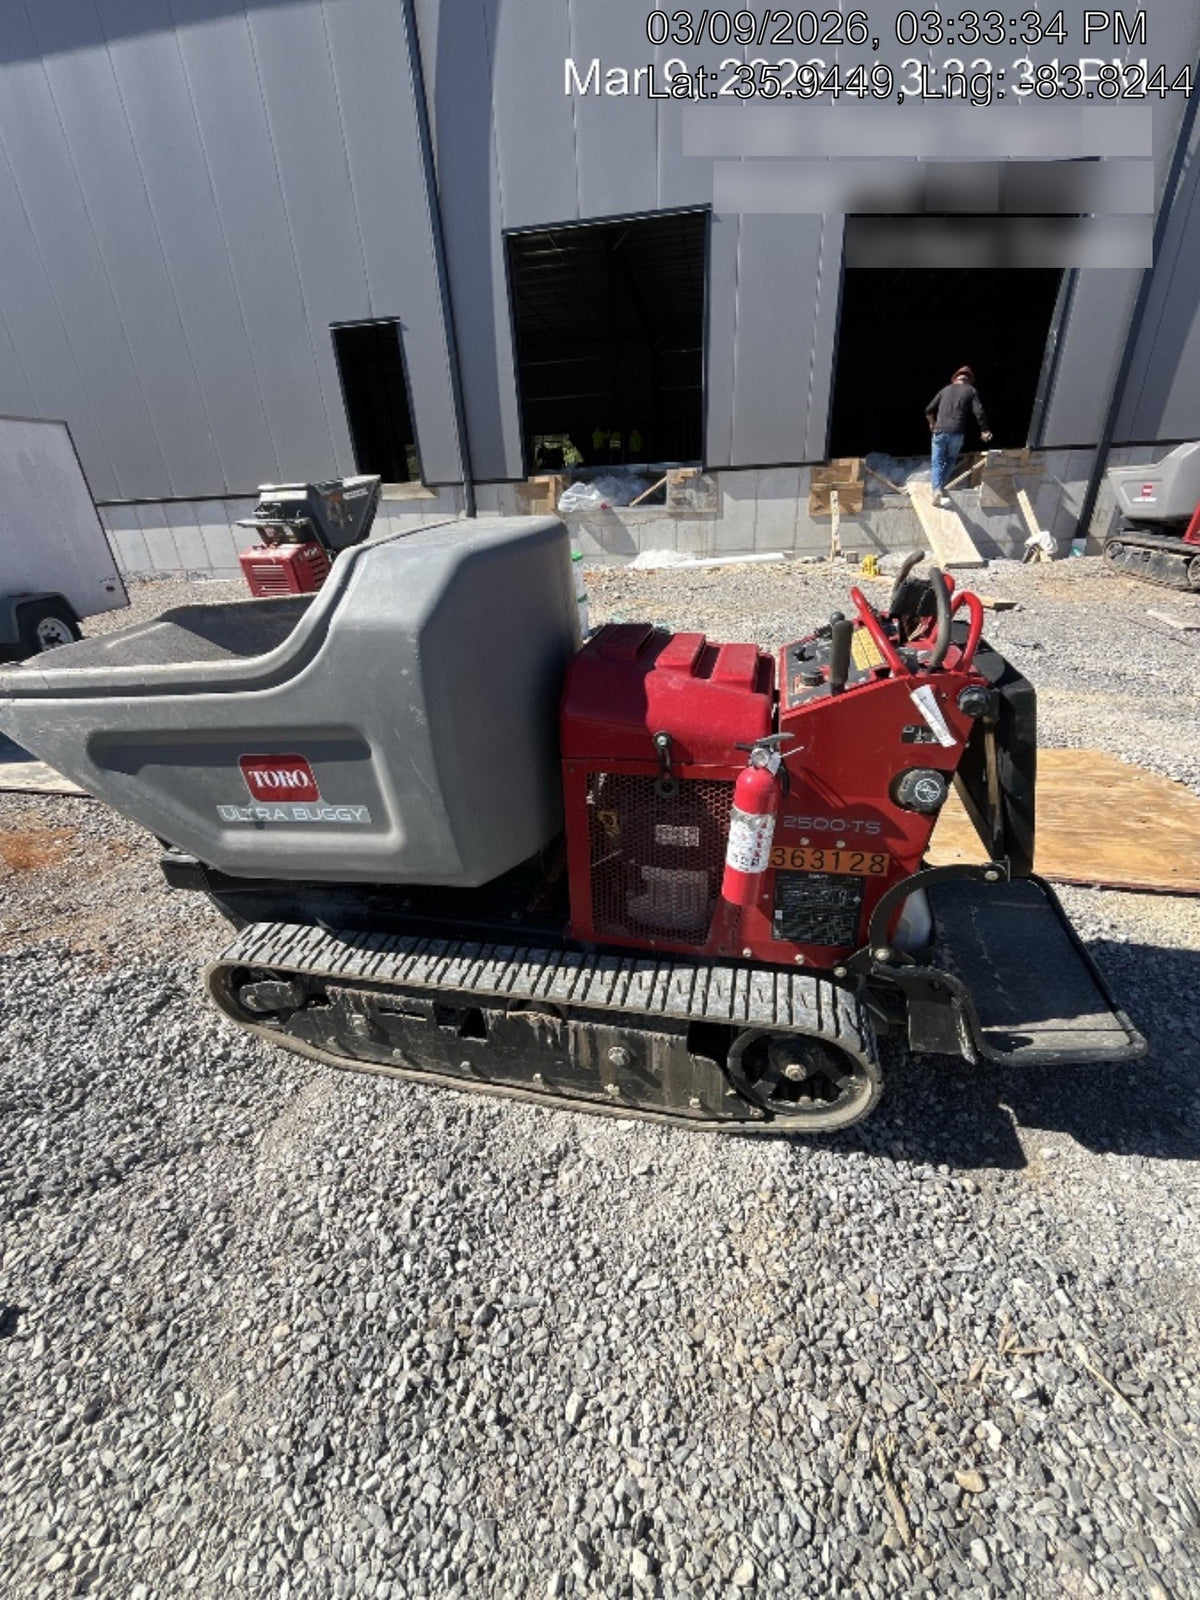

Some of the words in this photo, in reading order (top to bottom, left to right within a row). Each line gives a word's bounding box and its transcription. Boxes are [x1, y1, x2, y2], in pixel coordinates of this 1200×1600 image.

[248, 769, 309, 788] TORO
[220, 807, 289, 821] ULTRA
[292, 807, 364, 822] BUGGY
[772, 848, 887, 875] 363128
